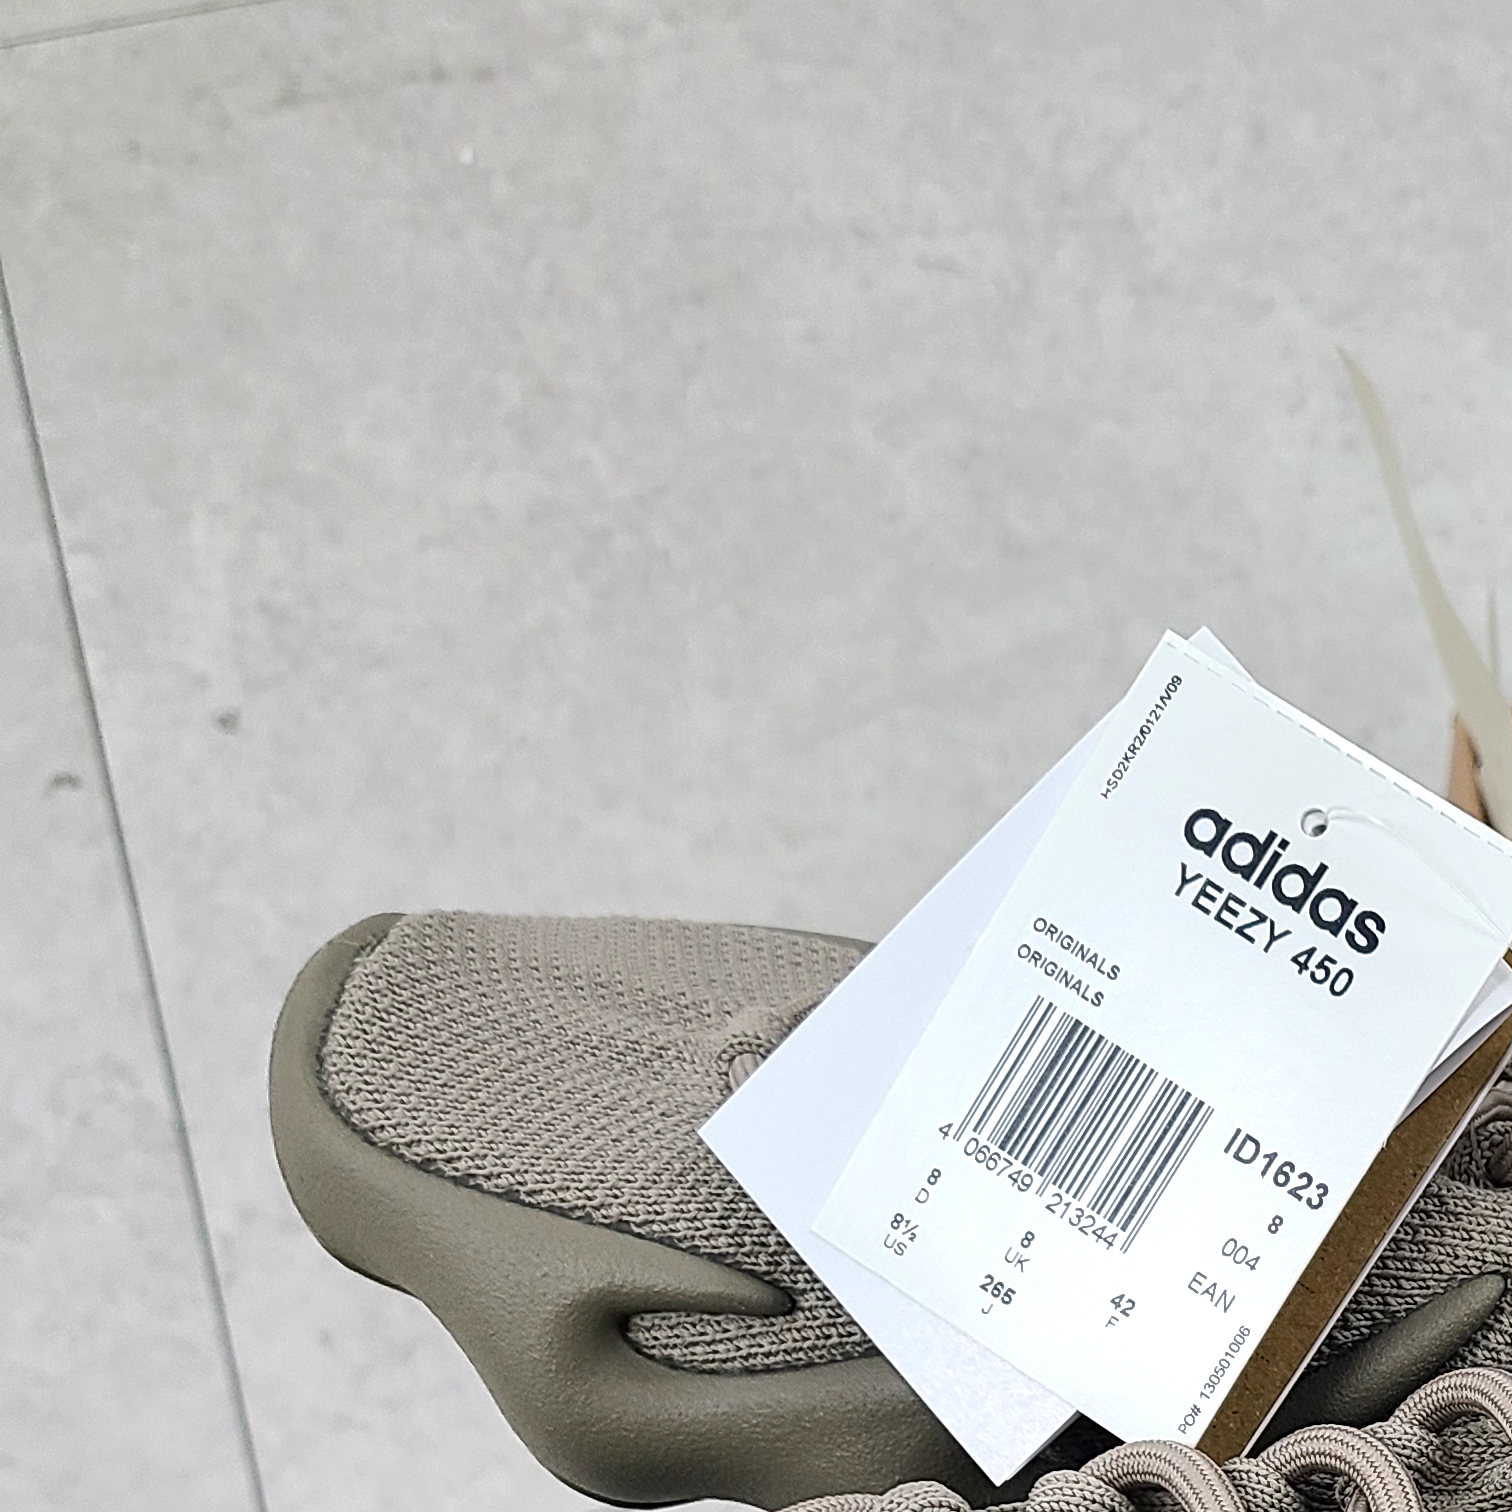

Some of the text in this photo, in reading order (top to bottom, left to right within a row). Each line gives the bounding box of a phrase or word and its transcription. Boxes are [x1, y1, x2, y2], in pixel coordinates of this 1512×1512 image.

[1184, 808, 1386, 954] adidas
[1174, 862, 1354, 997] YEEZY 450
[1033, 917, 1121, 981] ORIGINALS
[1017, 944, 1105, 1008] ORIGINALS
[927, 1168, 941, 1185] 8
[1223, 1128, 1329, 1210] ID1623
[915, 1188, 930, 1204] D
[938, 1123, 1118, 1250] 4 066749 213244
[1020, 1231, 1035, 1249] 8
[1267, 1214, 1284, 1234] 8
[883, 1233, 907, 1256] US
[1004, 1247, 1030, 1272] UK
[1221, 1238, 1261, 1271] 004
[979, 1274, 1016, 1305] 265
[1110, 1293, 1136, 1317] 42
[1187, 1271, 1236, 1313] EAN
[981, 1304, 993, 1314] J
[1177, 1325, 1251, 1434] PO# 130501006
